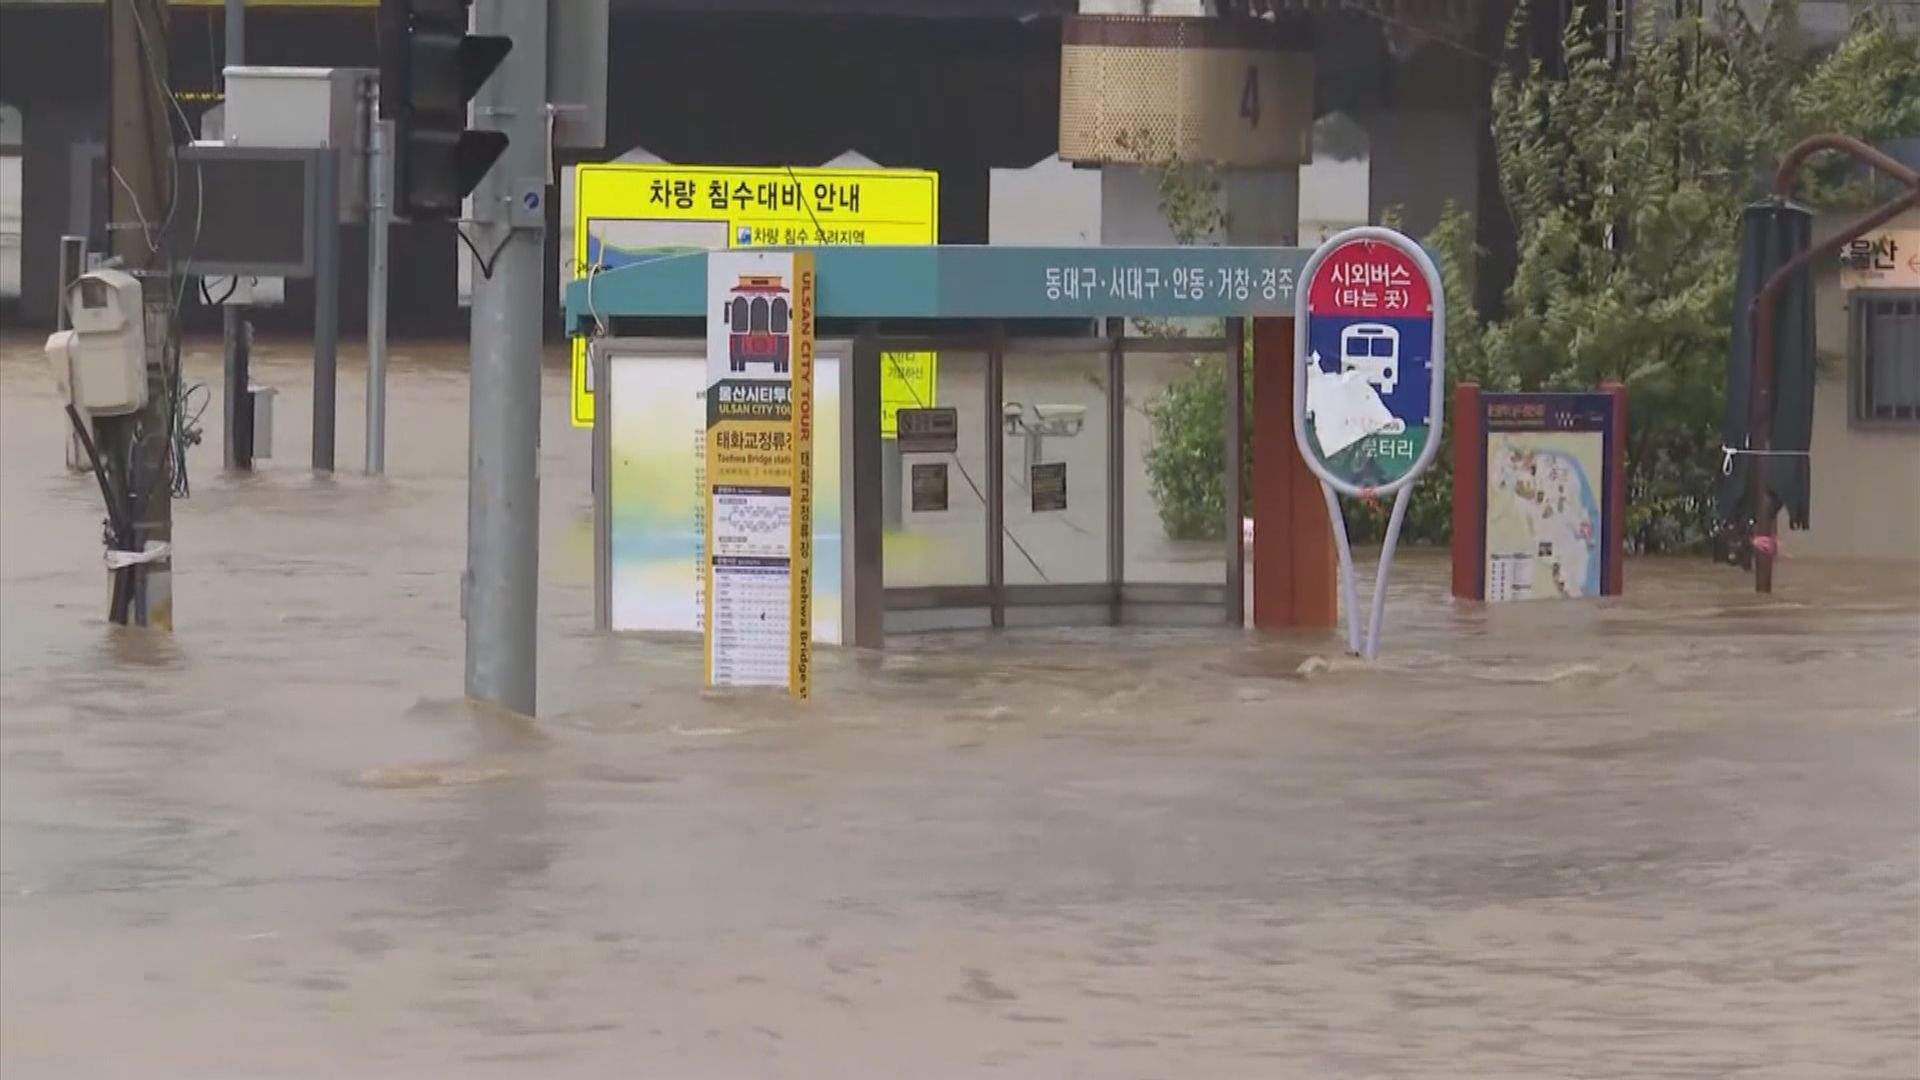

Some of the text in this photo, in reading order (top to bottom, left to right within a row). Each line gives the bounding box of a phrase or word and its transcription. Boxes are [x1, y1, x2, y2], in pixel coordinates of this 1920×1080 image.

[650, 180, 860, 213] 차량 침수대비 안내
[754, 227, 779, 245] 차량
[784, 228, 808, 245] 침수
[1331, 263, 1411, 287] 시외버스
[1335, 289, 1408, 308] (타는 곳)
[801, 271, 811, 441] ULSAN CITY TOUR
[719, 404, 750, 414] ULSAN
[752, 405, 772, 416] CITY
[800, 568, 809, 627] Taehwa
[798, 631, 808, 683] Bridge
